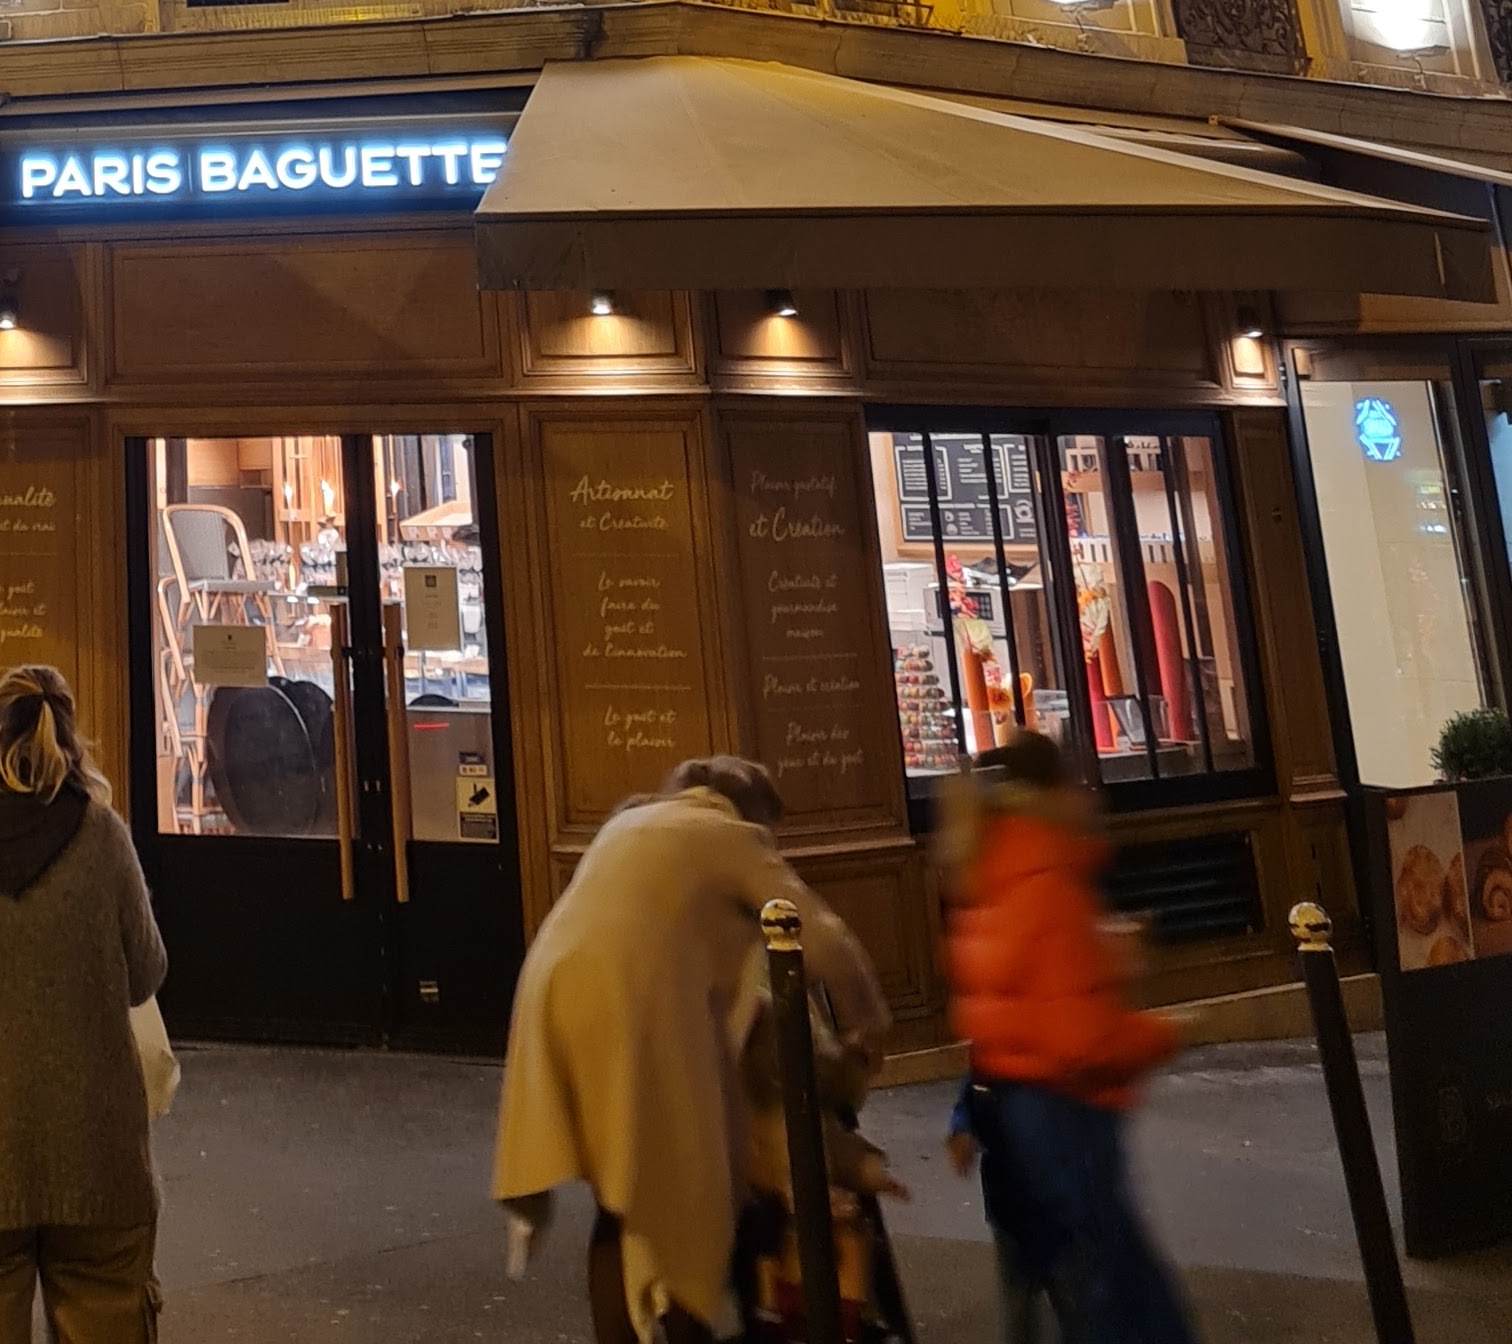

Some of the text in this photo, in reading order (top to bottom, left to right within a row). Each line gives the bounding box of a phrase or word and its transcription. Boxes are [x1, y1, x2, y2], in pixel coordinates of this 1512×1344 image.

[21, 141, 509, 199] PARIS BAGUETTE
[749, 511, 768, 538] et
